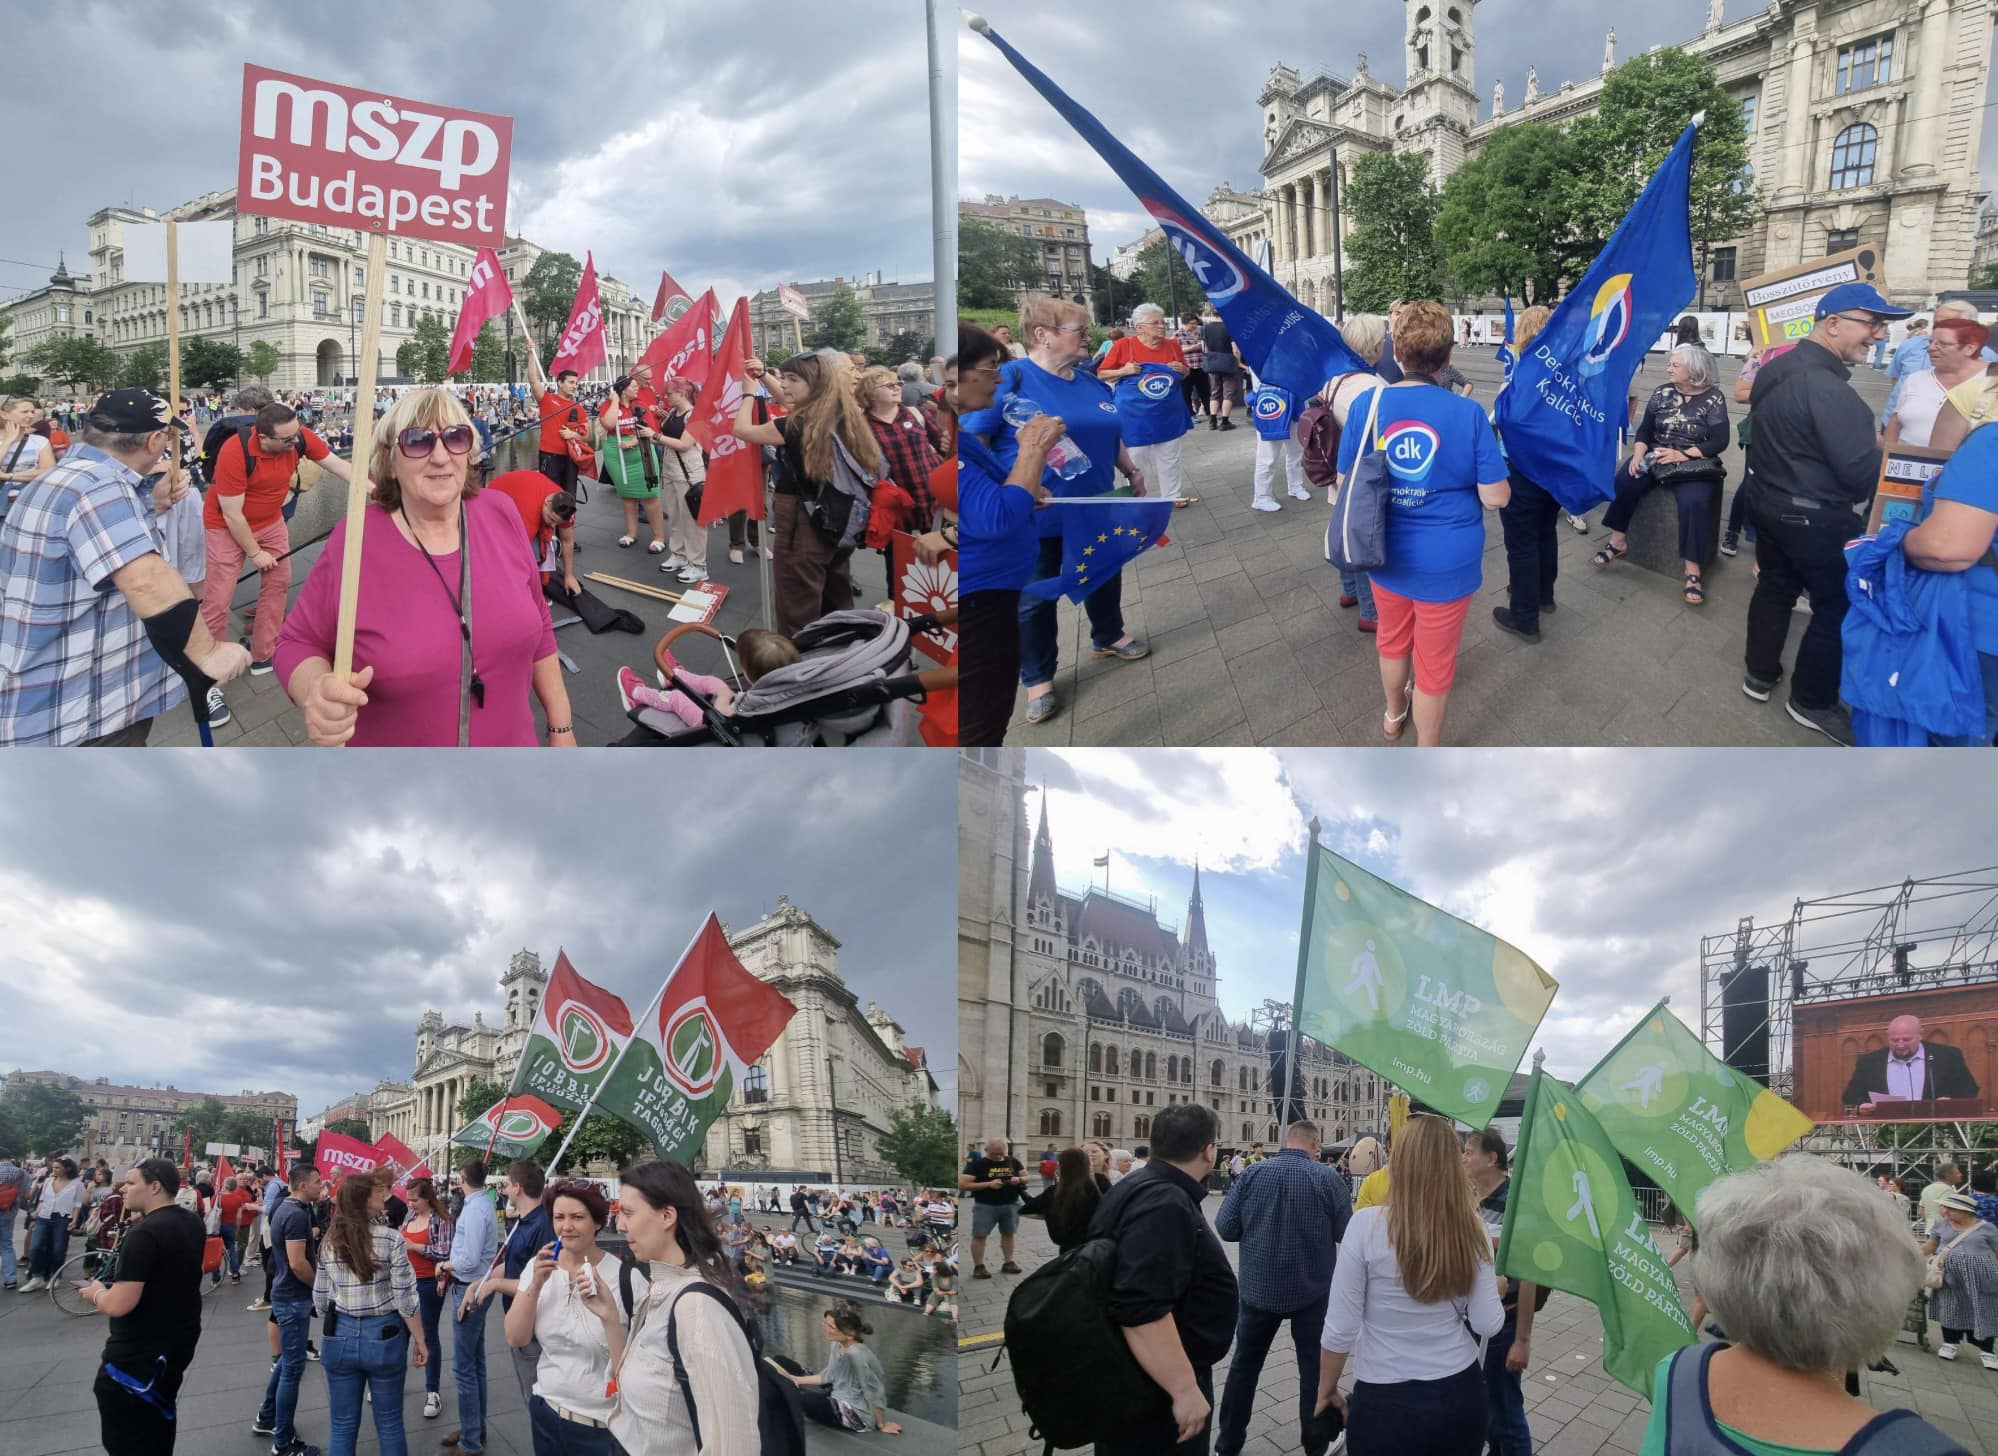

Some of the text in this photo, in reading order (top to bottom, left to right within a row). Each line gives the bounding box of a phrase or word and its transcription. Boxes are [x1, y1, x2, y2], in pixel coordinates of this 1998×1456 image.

[254, 79, 499, 191] mszp
[251, 153, 494, 232] Budapest
[1149, 380, 1164, 390] dk
[1535, 344, 1606, 423] Deokrikus
[1262, 401, 1276, 413] dk
[1395, 437, 1422, 459] dk
[1887, 461, 1912, 476] NE
[1391, 486, 1431, 497] mokratik
[1414, 974, 1483, 1018] LMP
[1392, 1056, 1432, 1084] lmp.hu
[1645, 1146, 1678, 1178] lmp.hu
